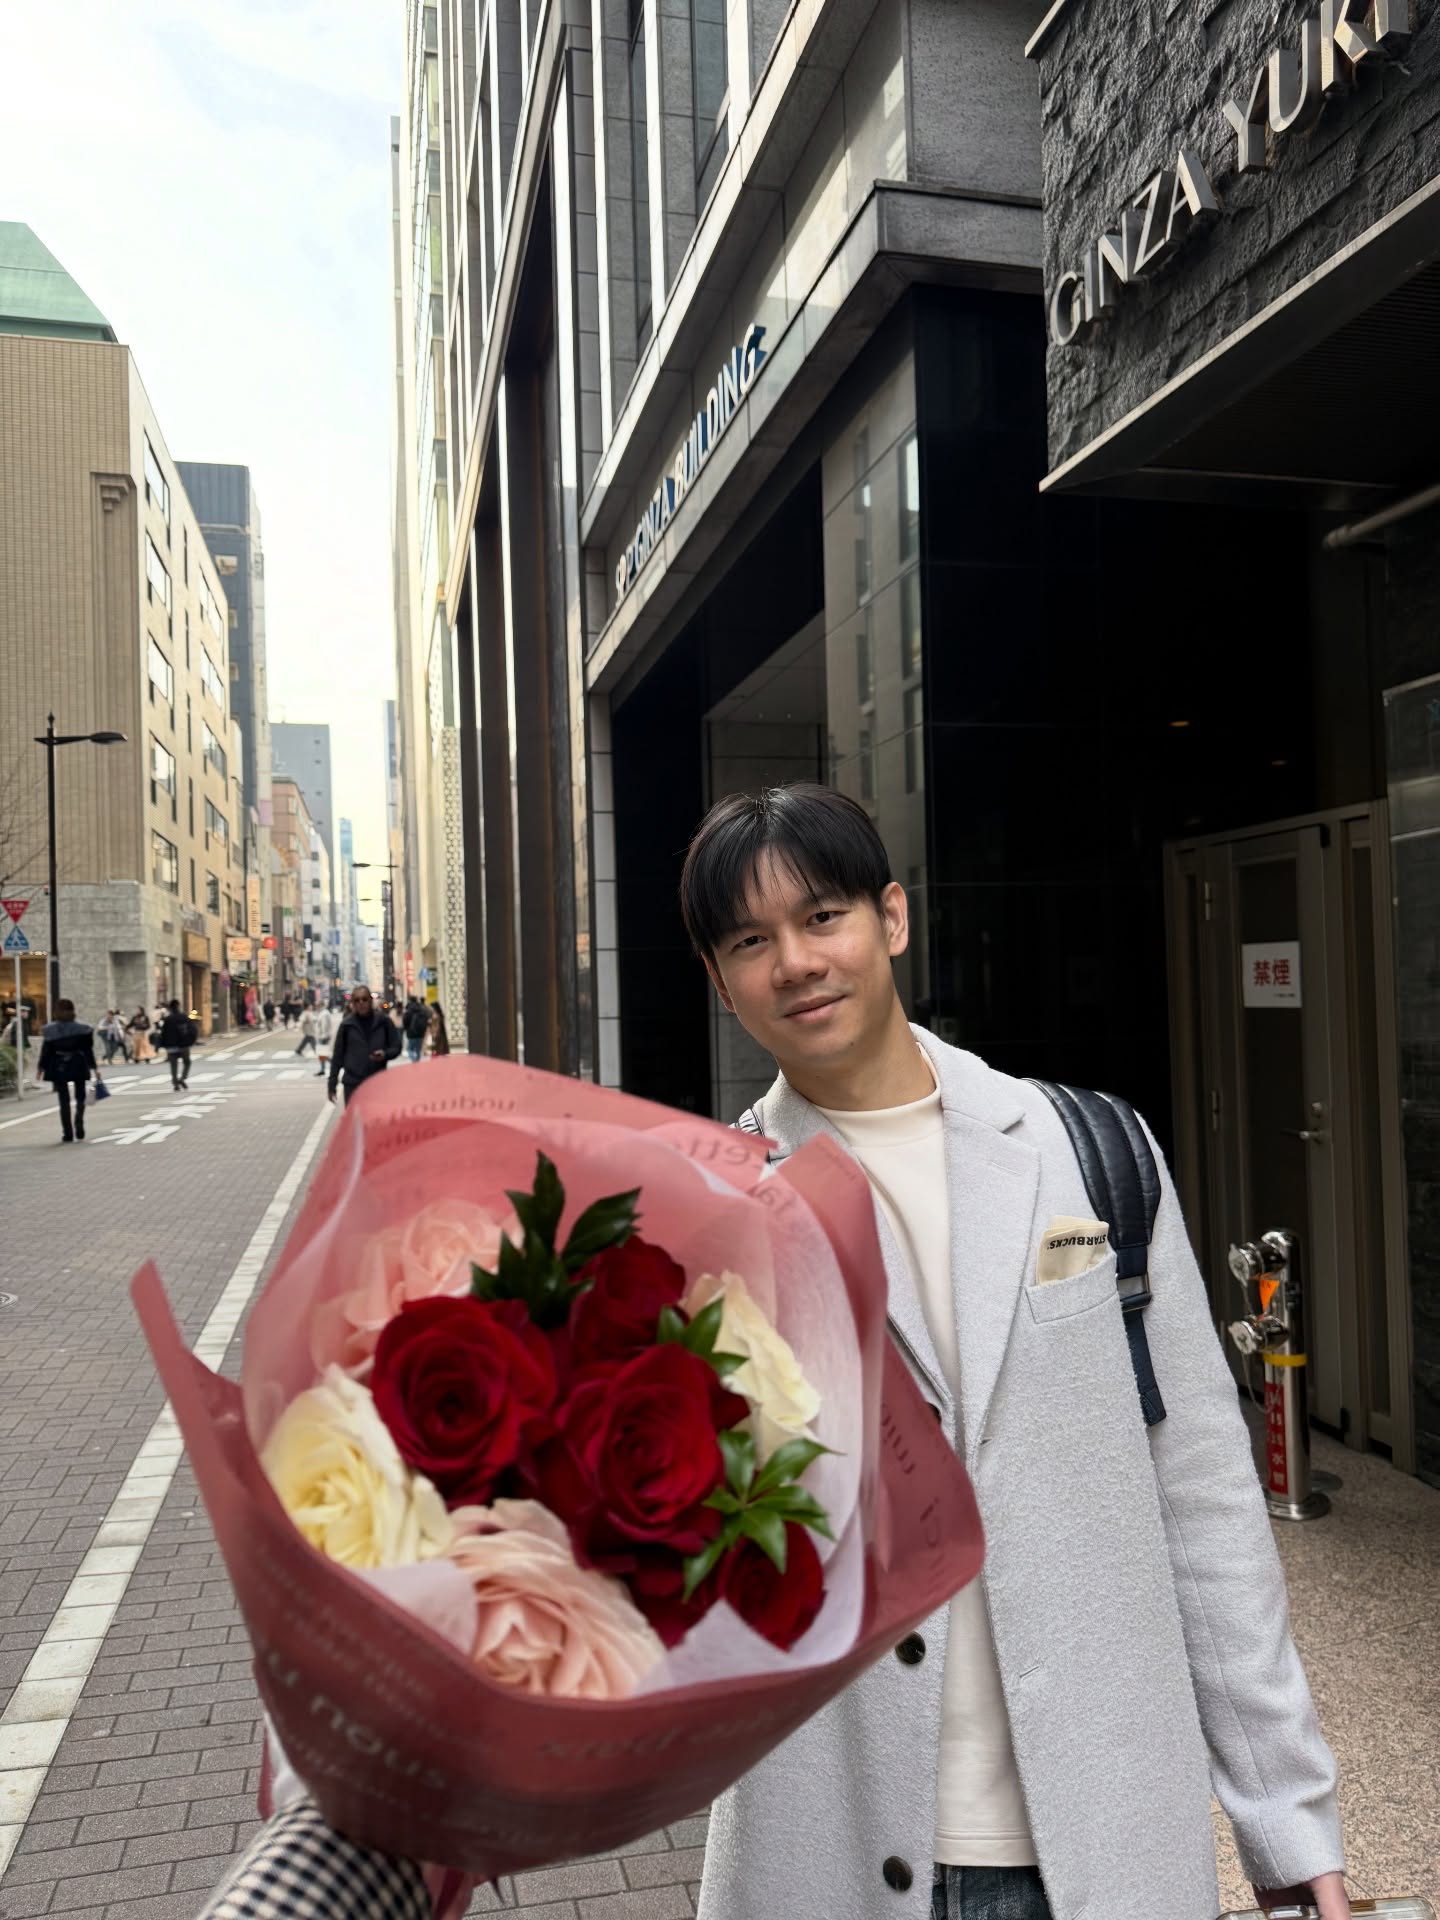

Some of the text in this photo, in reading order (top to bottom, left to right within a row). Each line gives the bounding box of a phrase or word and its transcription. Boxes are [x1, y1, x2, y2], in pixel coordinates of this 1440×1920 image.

[1050, 149, 1216, 346] GINZA
[635, 476, 674, 572] GINZA
[674, 322, 765, 503] BUILDING
[1254, 959, 1290, 986] 禁煙
[1048, 1234, 1107, 1249] STARBUCKS
